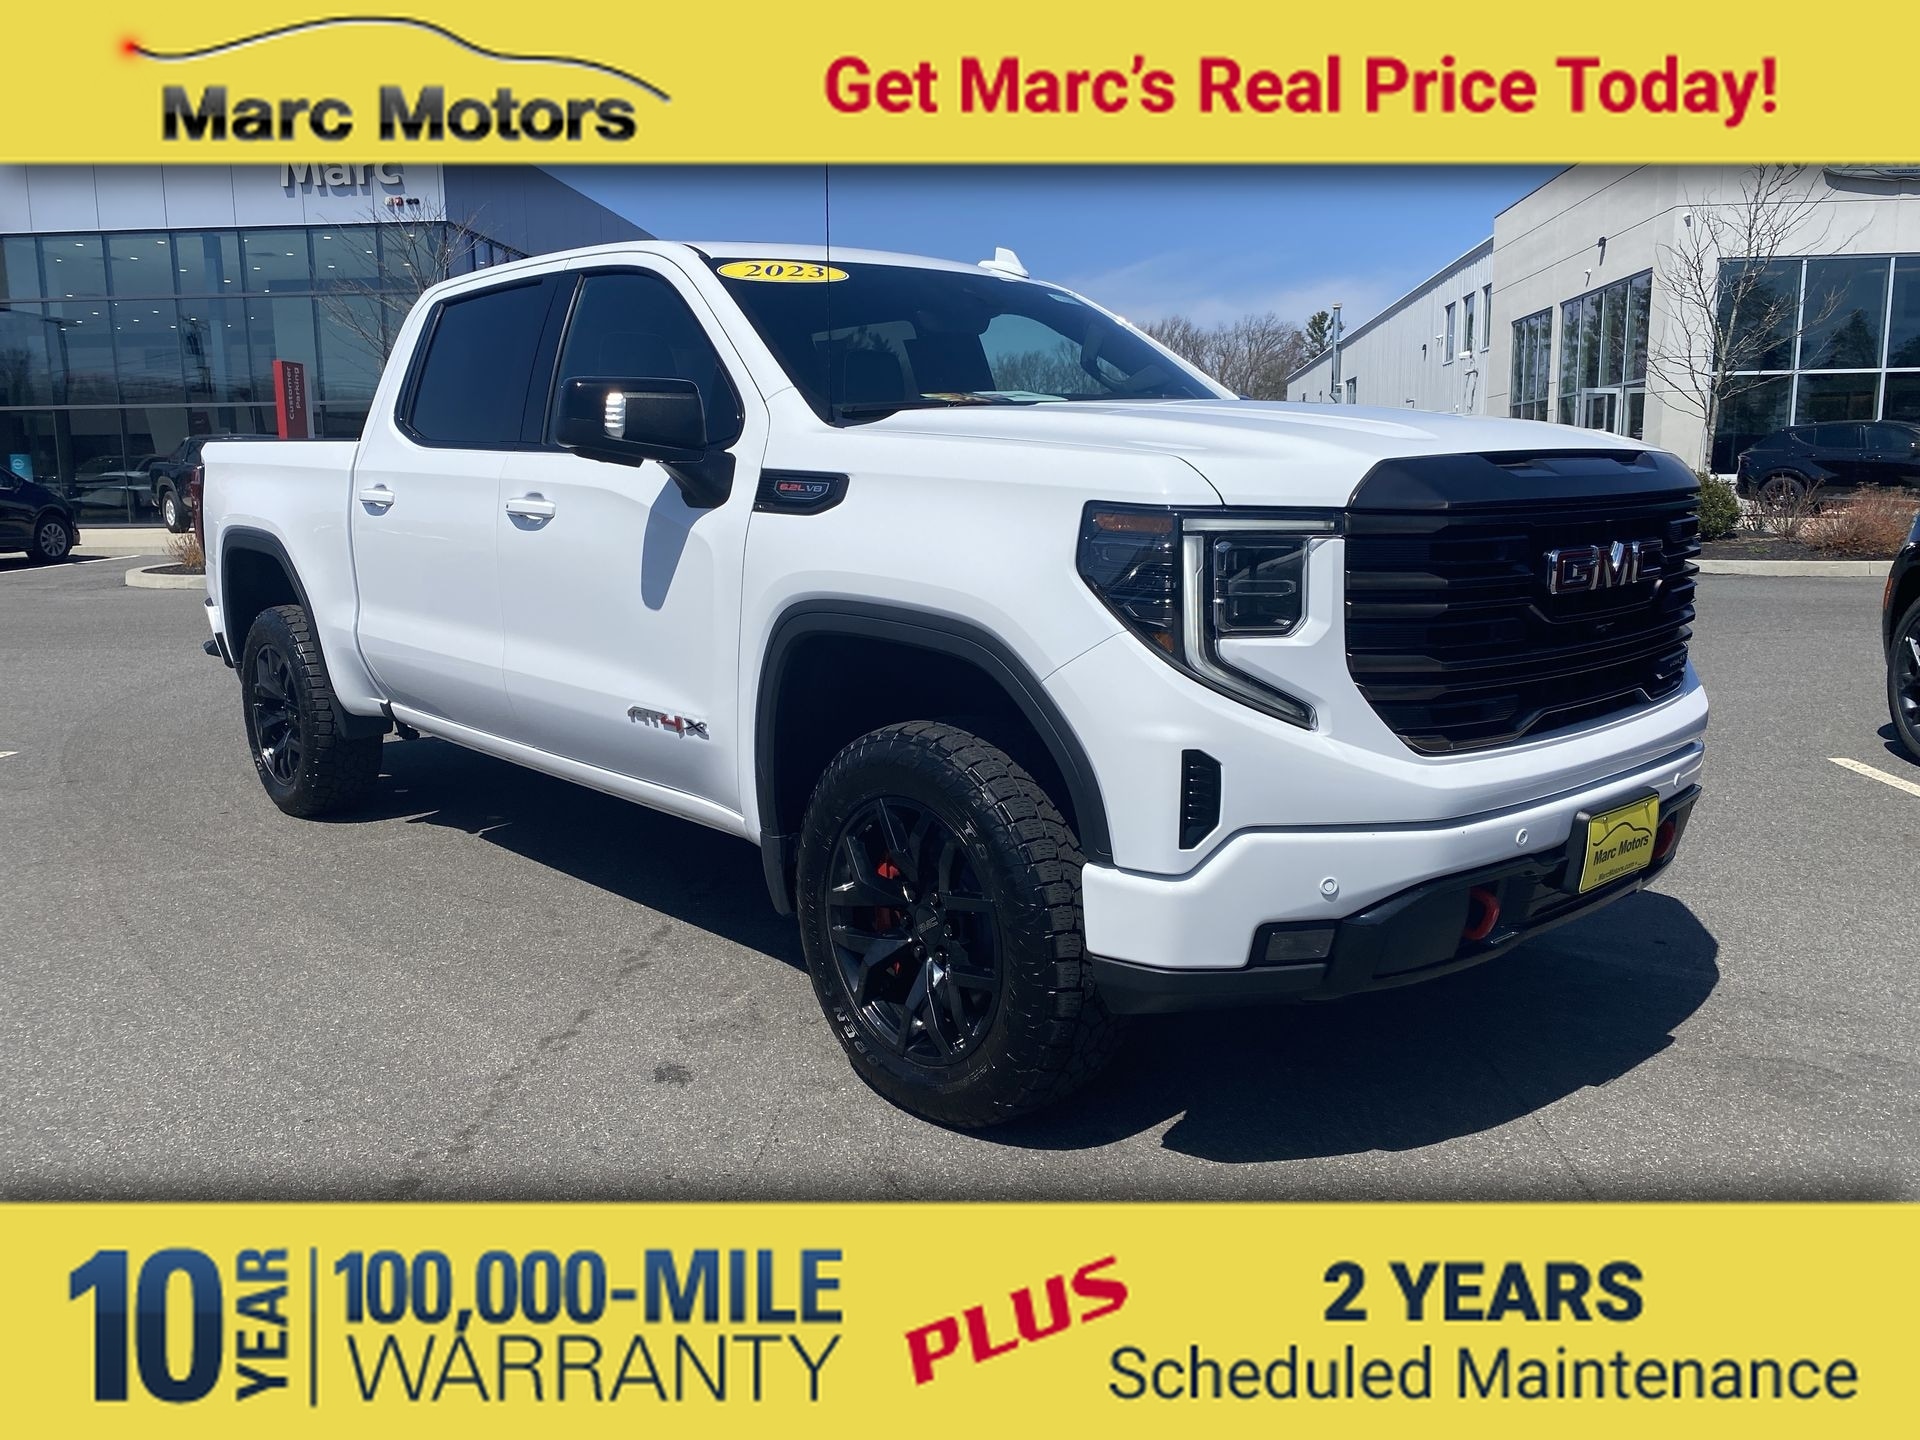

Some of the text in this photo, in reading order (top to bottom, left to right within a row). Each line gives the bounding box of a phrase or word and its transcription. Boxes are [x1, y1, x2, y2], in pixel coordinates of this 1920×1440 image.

[281, 162, 400, 187] Marc
[744, 263, 824, 278] 2023
[287, 366, 295, 420] Customer
[1547, 540, 1663, 595] GMC
[1593, 835, 1649, 866] Marc Motors
